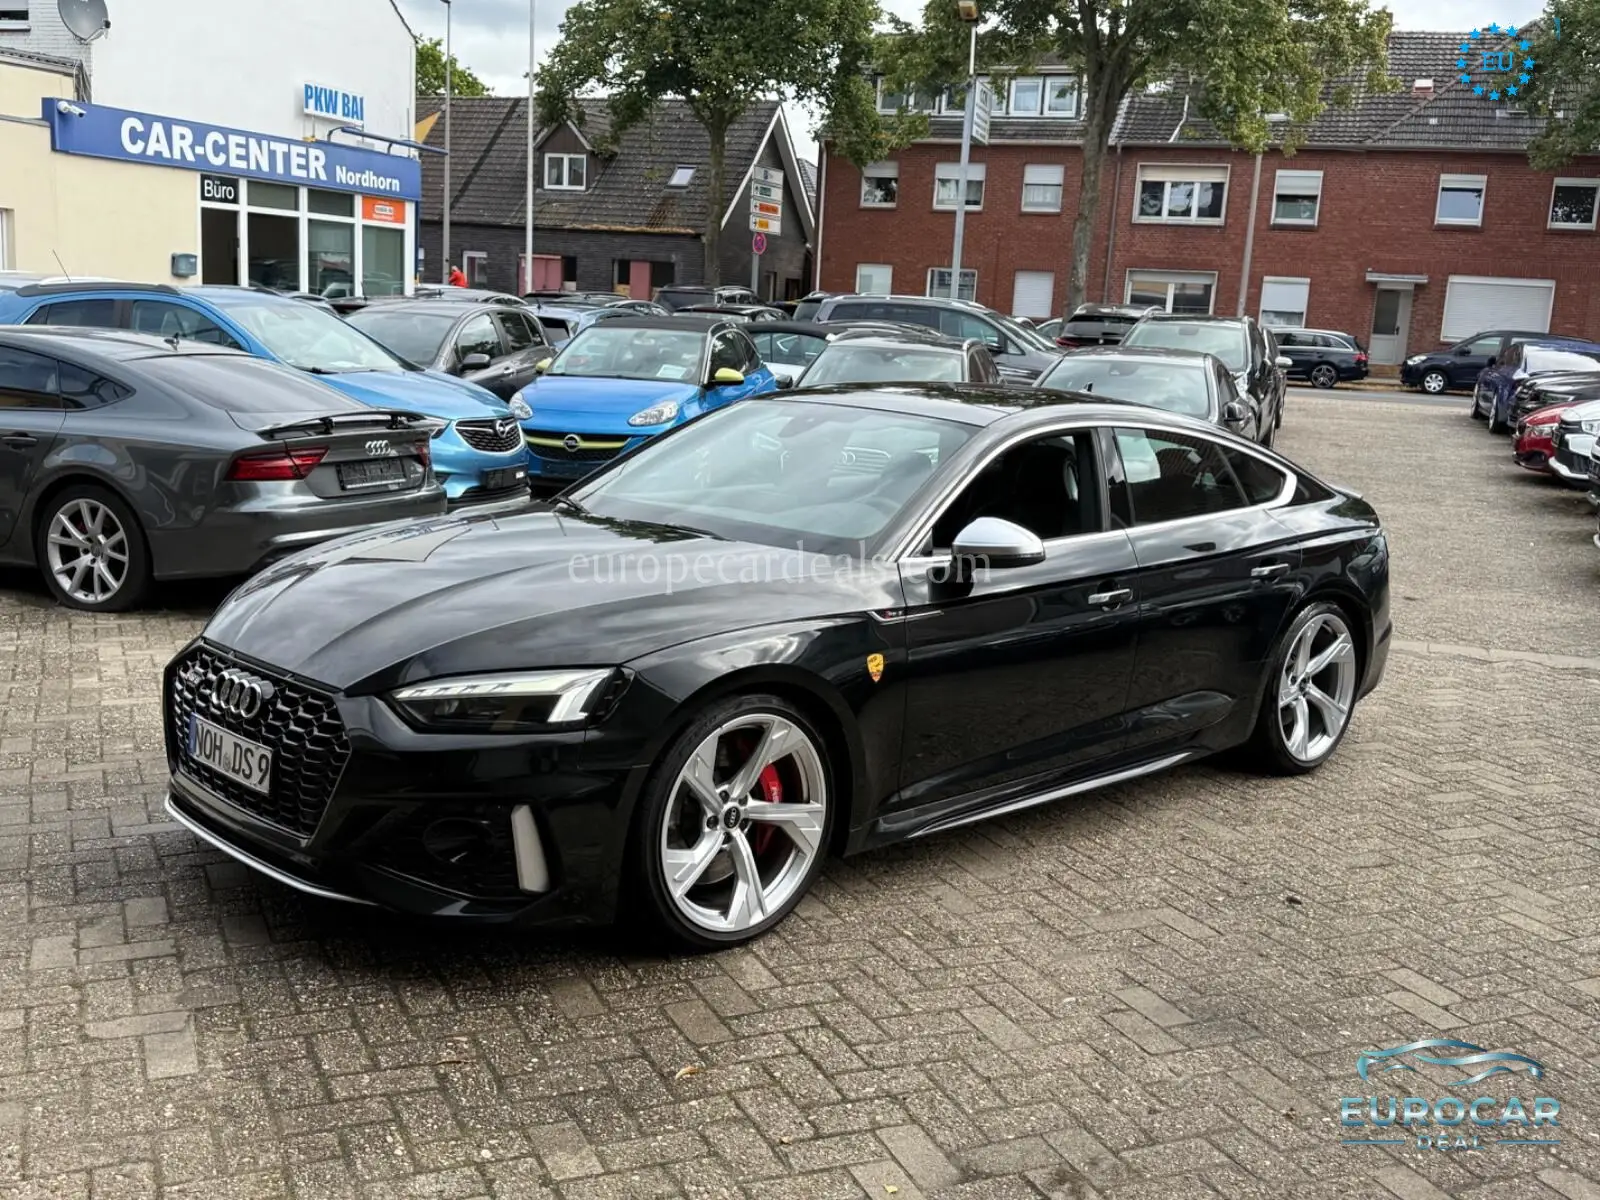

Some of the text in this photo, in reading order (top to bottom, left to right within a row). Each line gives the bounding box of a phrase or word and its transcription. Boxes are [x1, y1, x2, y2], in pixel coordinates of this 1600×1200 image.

[304, 83, 339, 115] PKW
[120, 116, 401, 192] CAR-CENTER Nordhorn
[204, 179, 235, 199] Büro
[196, 722, 270, 786] NOH DS 9
